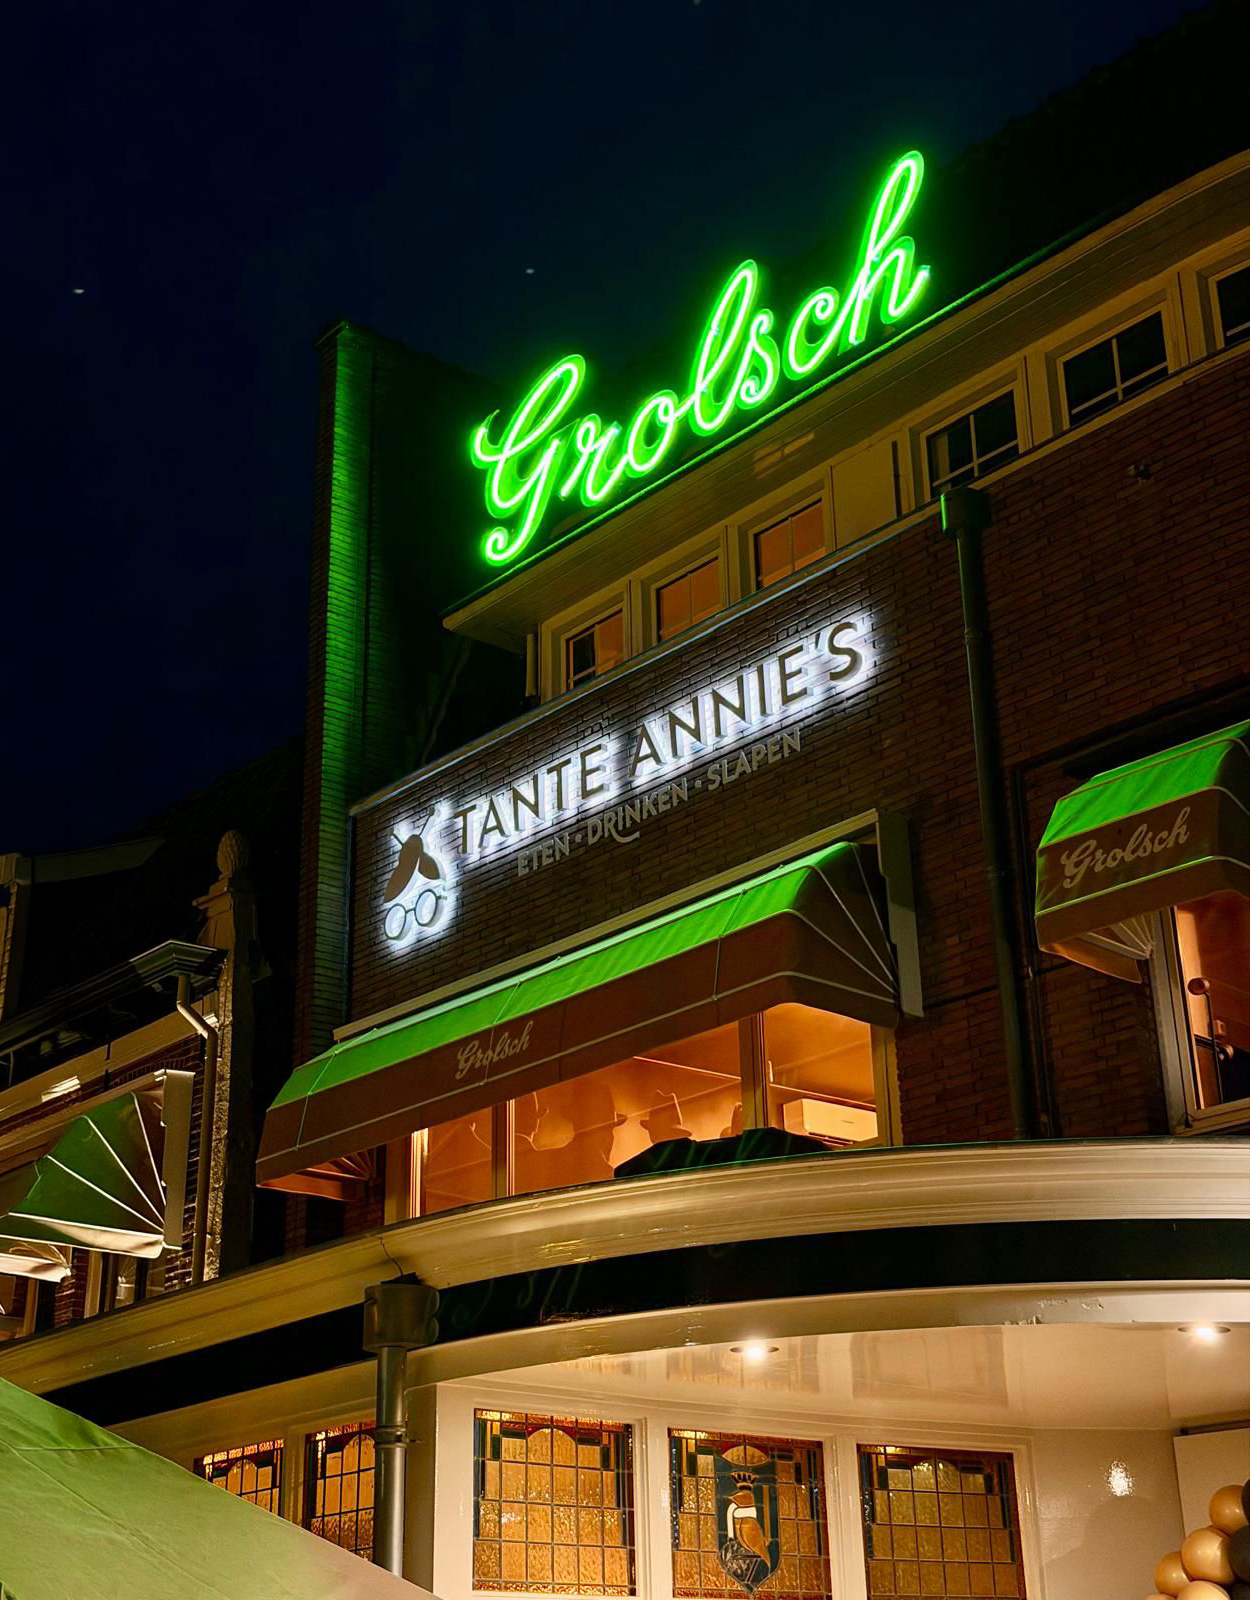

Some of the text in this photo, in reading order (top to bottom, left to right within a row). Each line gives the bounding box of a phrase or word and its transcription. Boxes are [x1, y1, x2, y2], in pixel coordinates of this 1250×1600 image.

[471, 150, 930, 566] Grolsch
[454, 622, 863, 855] TANTE ANNIE'S
[517, 727, 801, 877] ETEN DRINKEN SLAPEN
[1060, 806, 1191, 889] Grolsch
[455, 1020, 534, 1080] Grolsch
